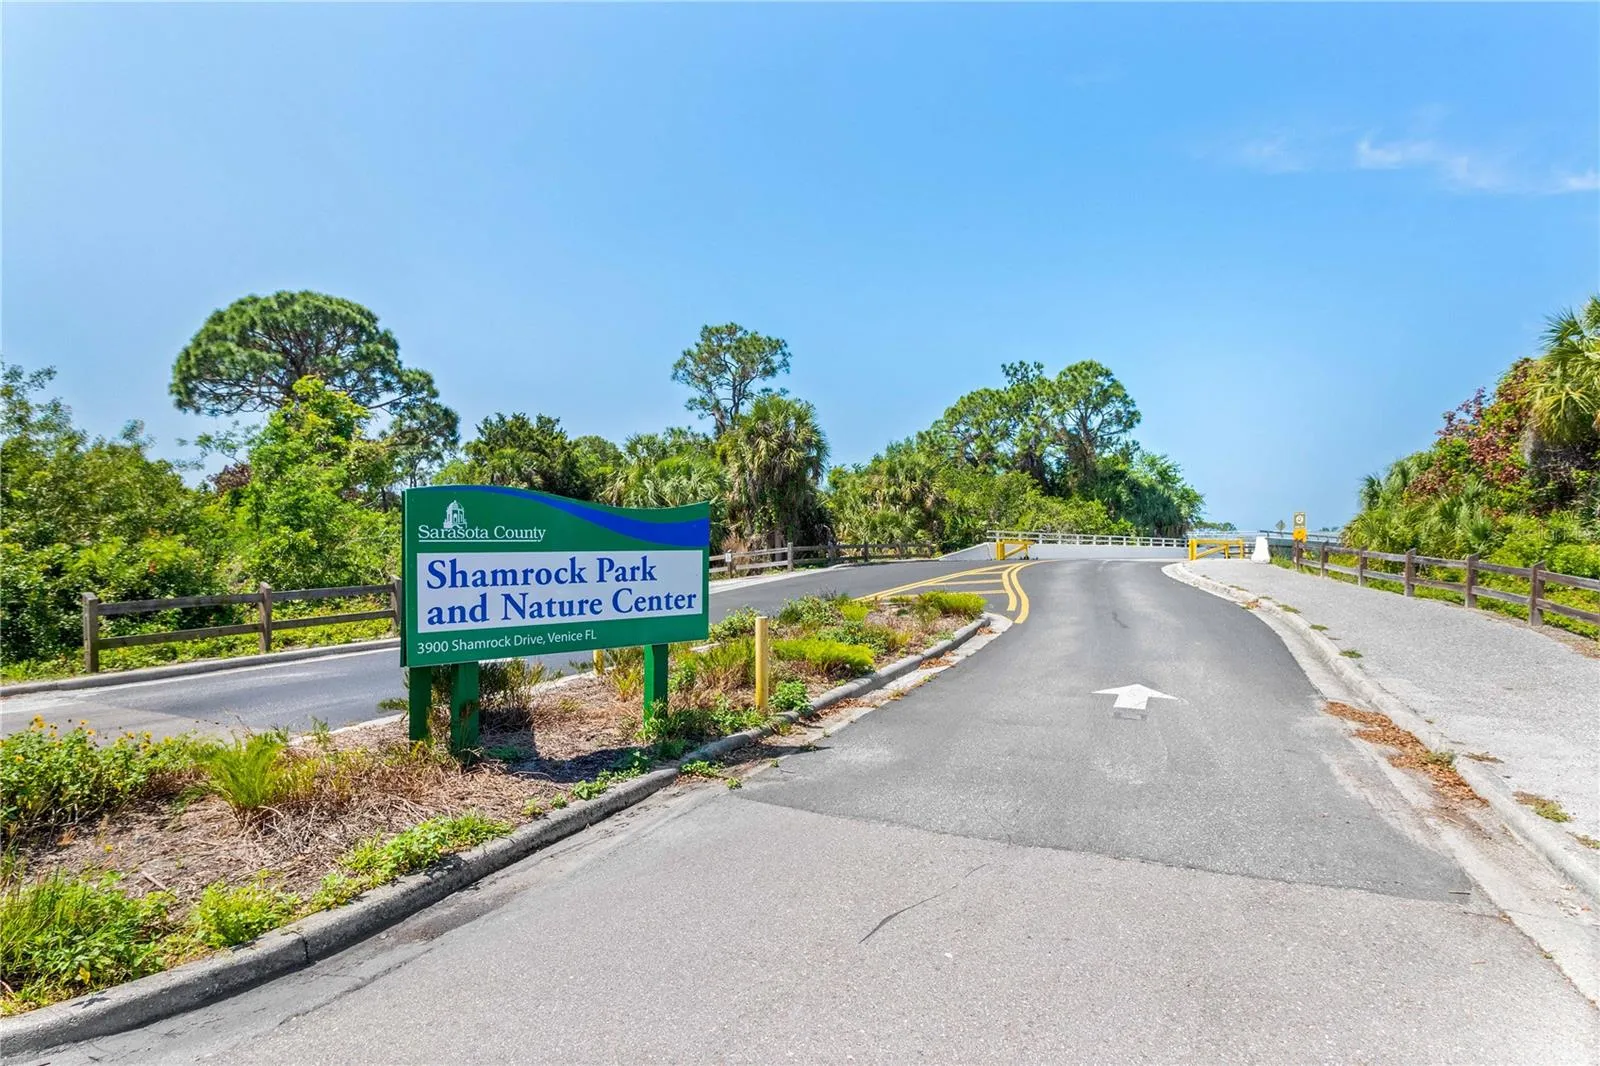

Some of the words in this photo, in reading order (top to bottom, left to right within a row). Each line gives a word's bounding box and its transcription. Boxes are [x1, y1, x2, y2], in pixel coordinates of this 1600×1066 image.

[418, 525, 489, 540] Sarasota
[493, 525, 546, 542] County
[426, 556, 588, 590] Shamrock
[596, 555, 657, 583] Park
[427, 592, 490, 626] and
[501, 592, 603, 621] Nature
[612, 588, 697, 614] Center
[417, 641, 449, 655] 3900
[452, 635, 511, 652] Shamrock
[514, 633, 546, 646] Drive,
[548, 630, 583, 643] Venice
[585, 629, 597, 640] FL
